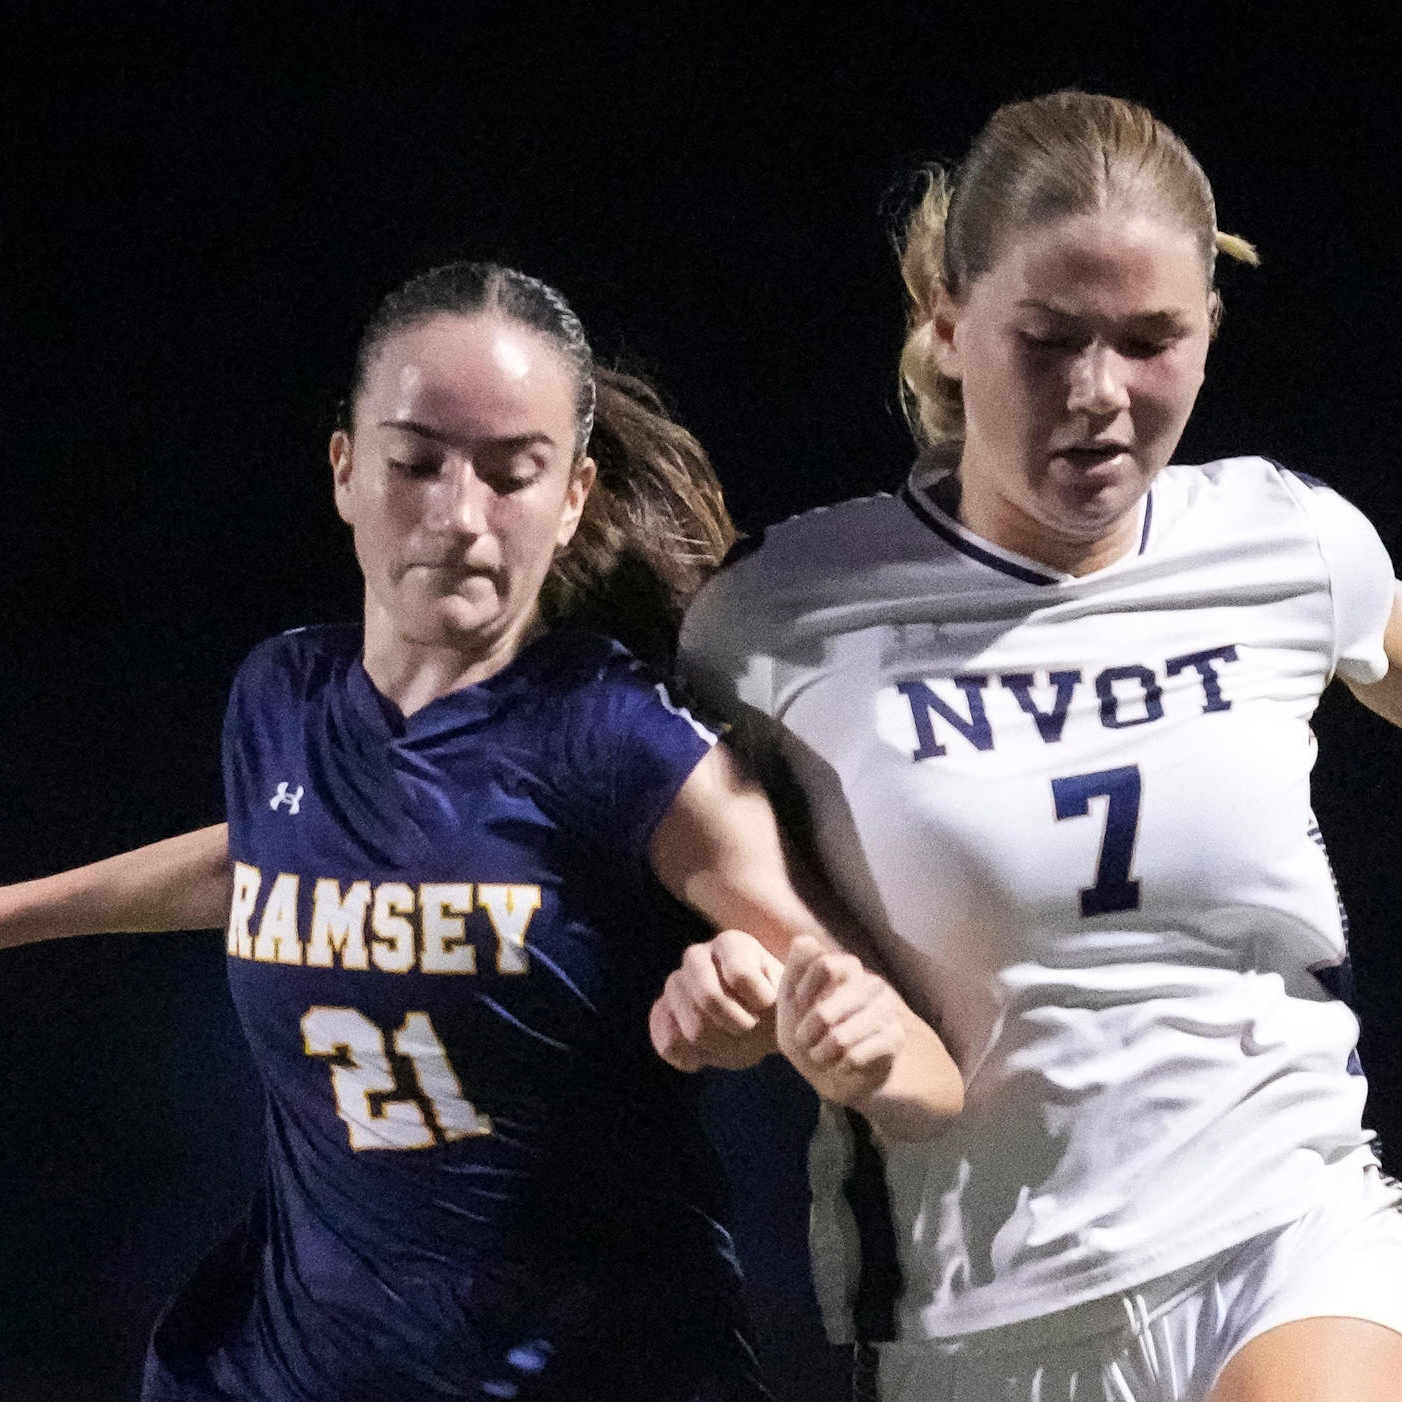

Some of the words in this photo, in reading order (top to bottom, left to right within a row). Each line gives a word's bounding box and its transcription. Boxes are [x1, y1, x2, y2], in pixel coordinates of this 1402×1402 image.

[898, 644, 1239, 762] NVOT
[1051, 764, 1142, 917] 7
[227, 861, 542, 976] RAMSEY
[299, 1005, 493, 1152] 21
